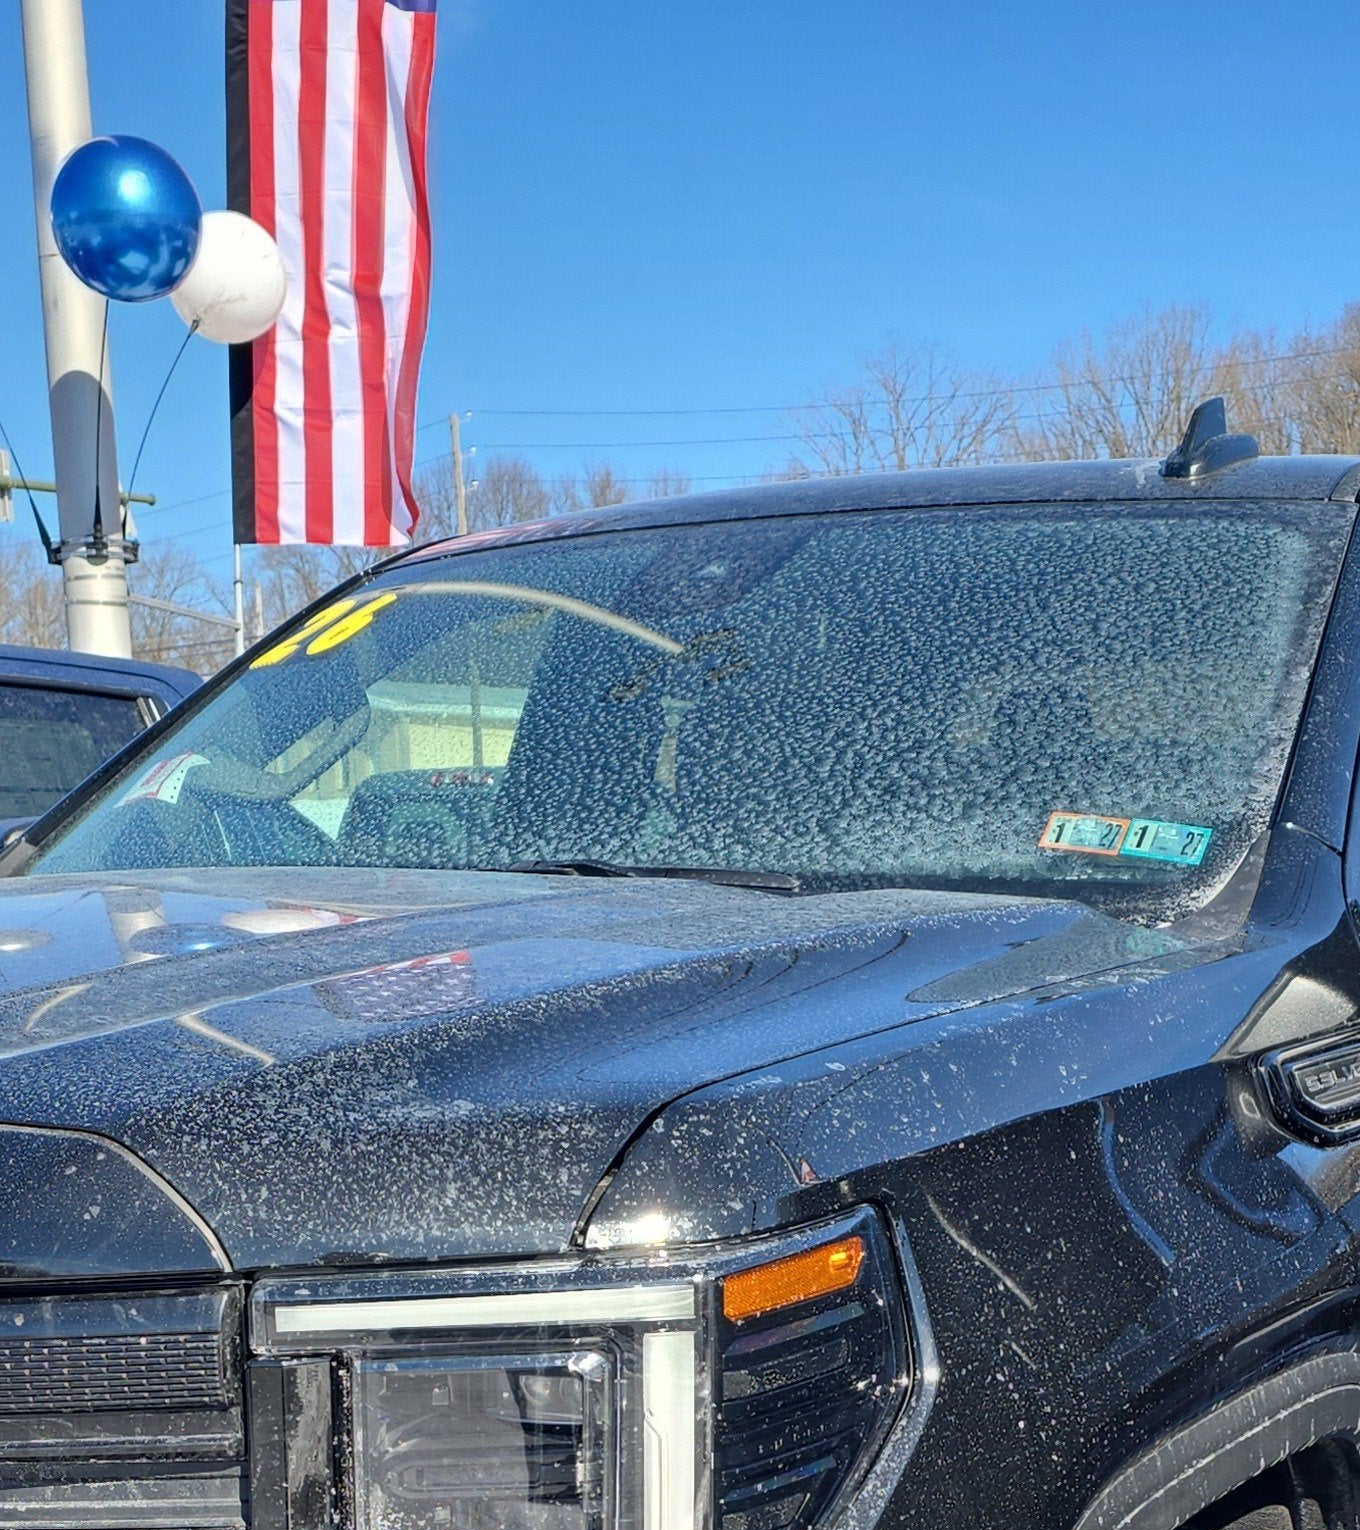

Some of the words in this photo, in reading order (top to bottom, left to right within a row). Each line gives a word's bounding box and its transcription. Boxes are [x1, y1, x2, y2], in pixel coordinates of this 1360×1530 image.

[1054, 822, 1066, 844] 1
[1099, 822, 1124, 849] 27
[1135, 824, 1150, 849] 1
[1180, 831, 1205, 858] 27
